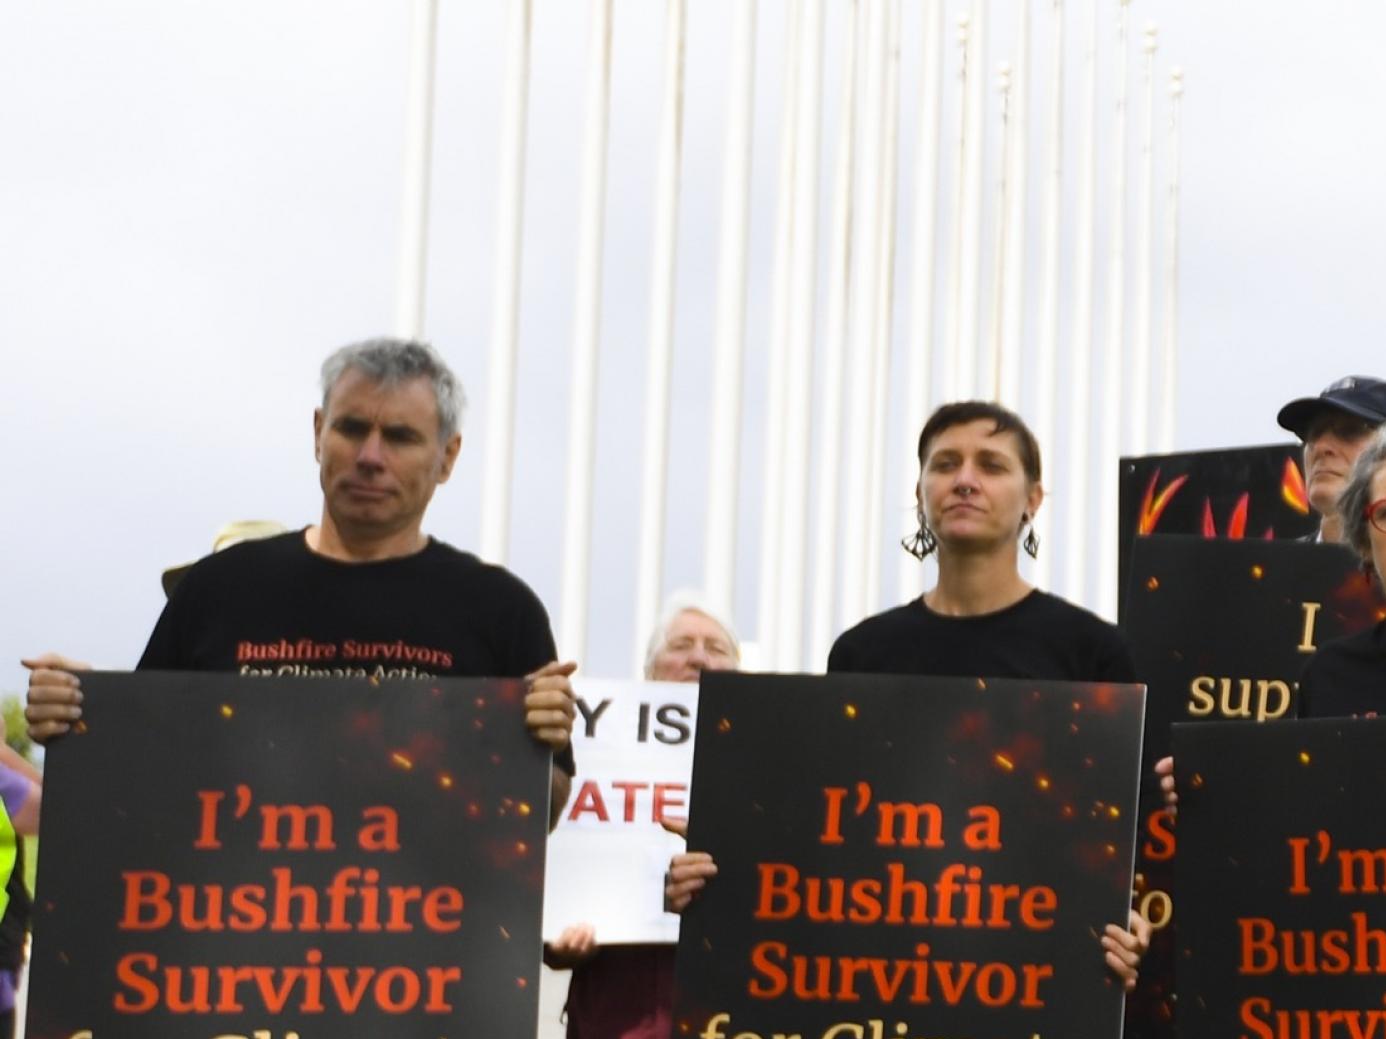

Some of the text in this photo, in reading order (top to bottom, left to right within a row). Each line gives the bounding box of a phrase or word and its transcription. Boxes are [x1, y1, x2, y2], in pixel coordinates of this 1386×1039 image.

[1298, 602, 1321, 651] I
[237, 639, 453, 667] Bushfire Survivors
[373, 665, 438, 680] Acti
[1188, 676, 1299, 722] sup
[637, 702, 691, 744] IS
[568, 779, 688, 823] ATE
[358, 806, 399, 852] a
[963, 805, 1001, 851] a
[118, 866, 464, 933] Bushfire
[755, 861, 1057, 931] Bushfire
[114, 949, 461, 1014] Survivor
[748, 941, 1054, 1008] Survivor
